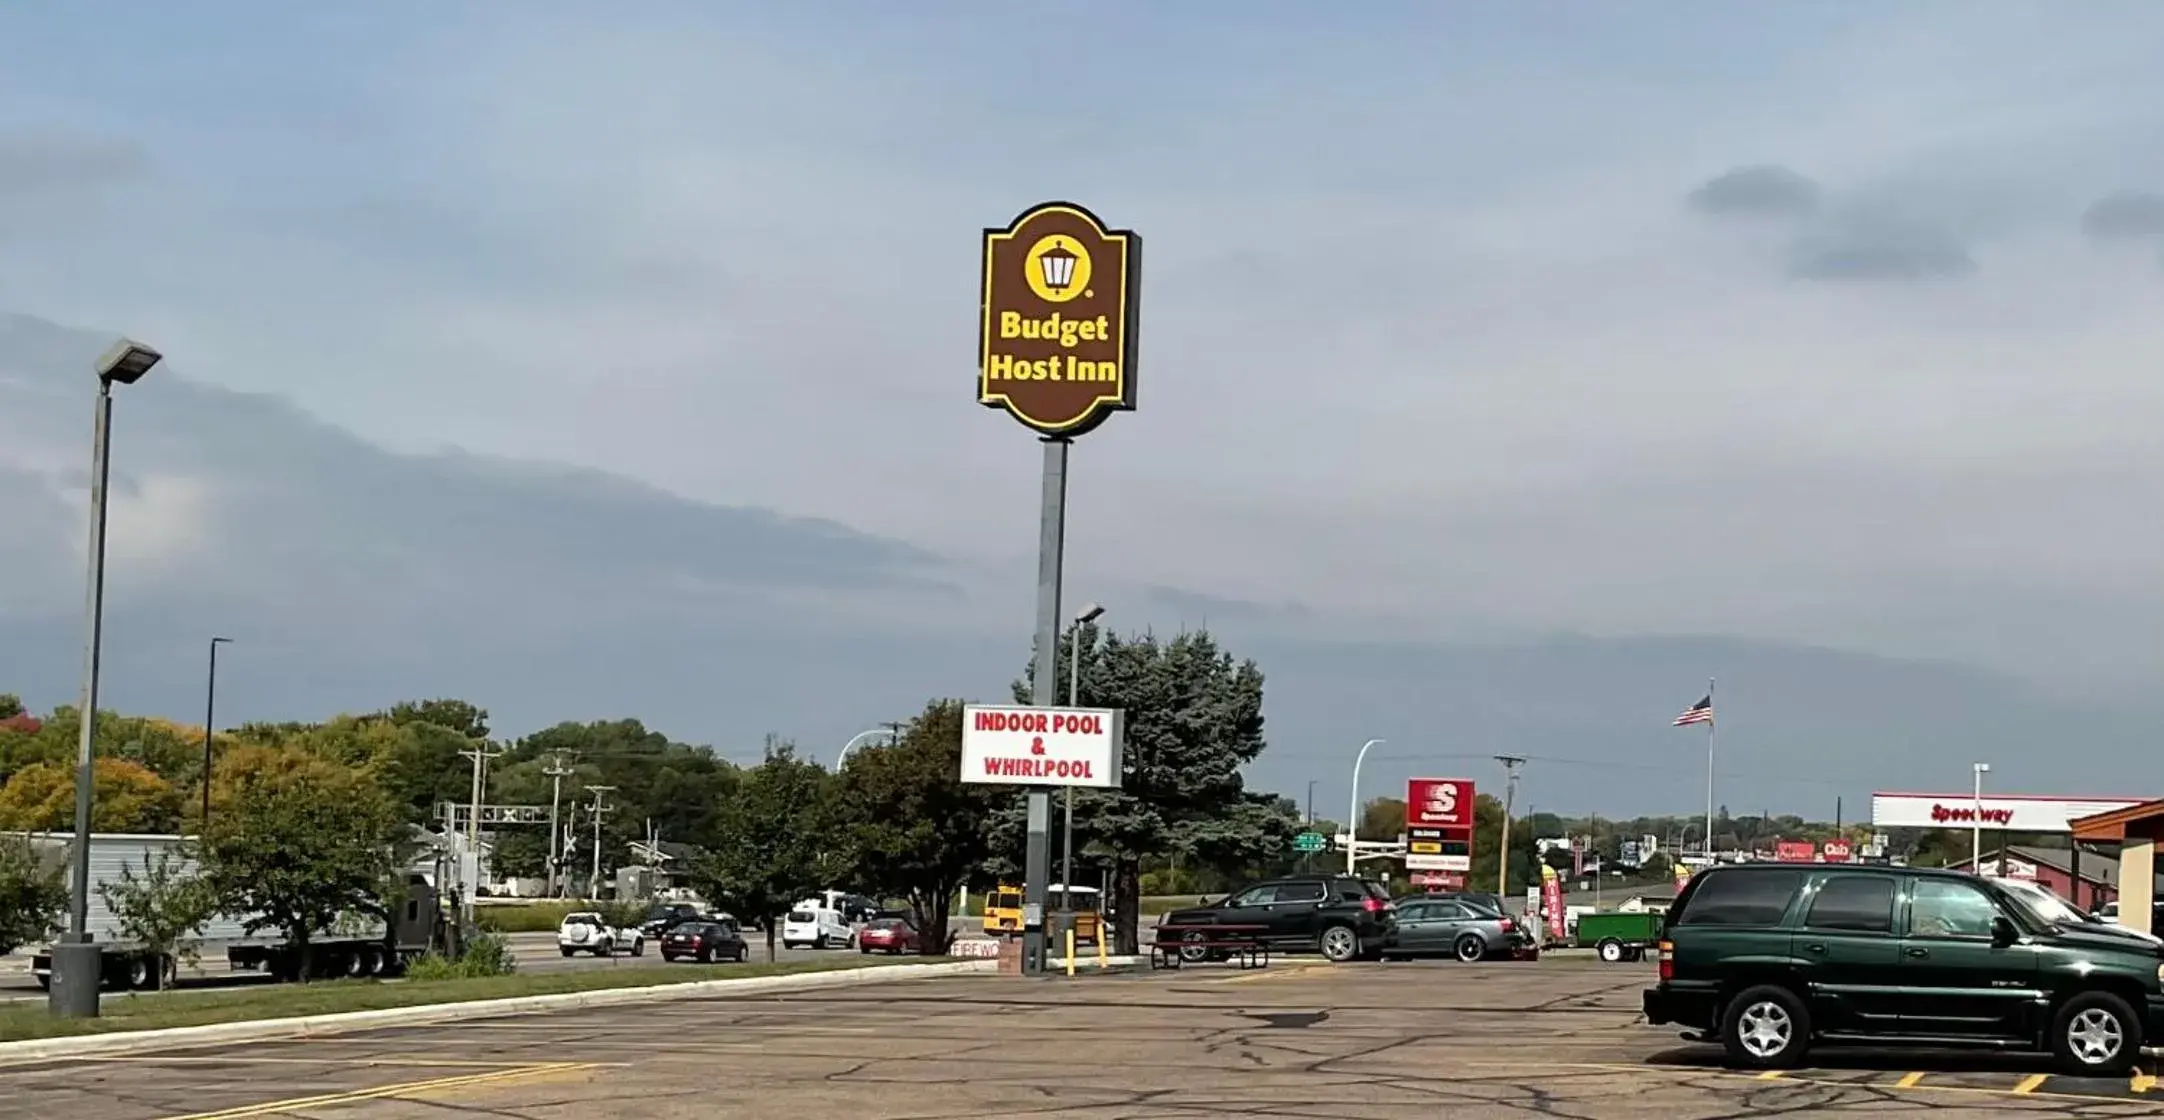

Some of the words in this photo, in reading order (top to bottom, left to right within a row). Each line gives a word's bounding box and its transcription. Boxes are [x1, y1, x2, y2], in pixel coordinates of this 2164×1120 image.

[1000, 310, 1109, 348] Budget
[989, 354, 1062, 381] Host
[1066, 355, 1117, 382] Inn
[974, 711, 1048, 733] INDOOR
[1052, 713, 1103, 735] POOL
[1031, 736, 1046, 756] &
[983, 756, 1094, 779] WHIRLPOOL
[1931, 803, 2014, 826] Speedway
